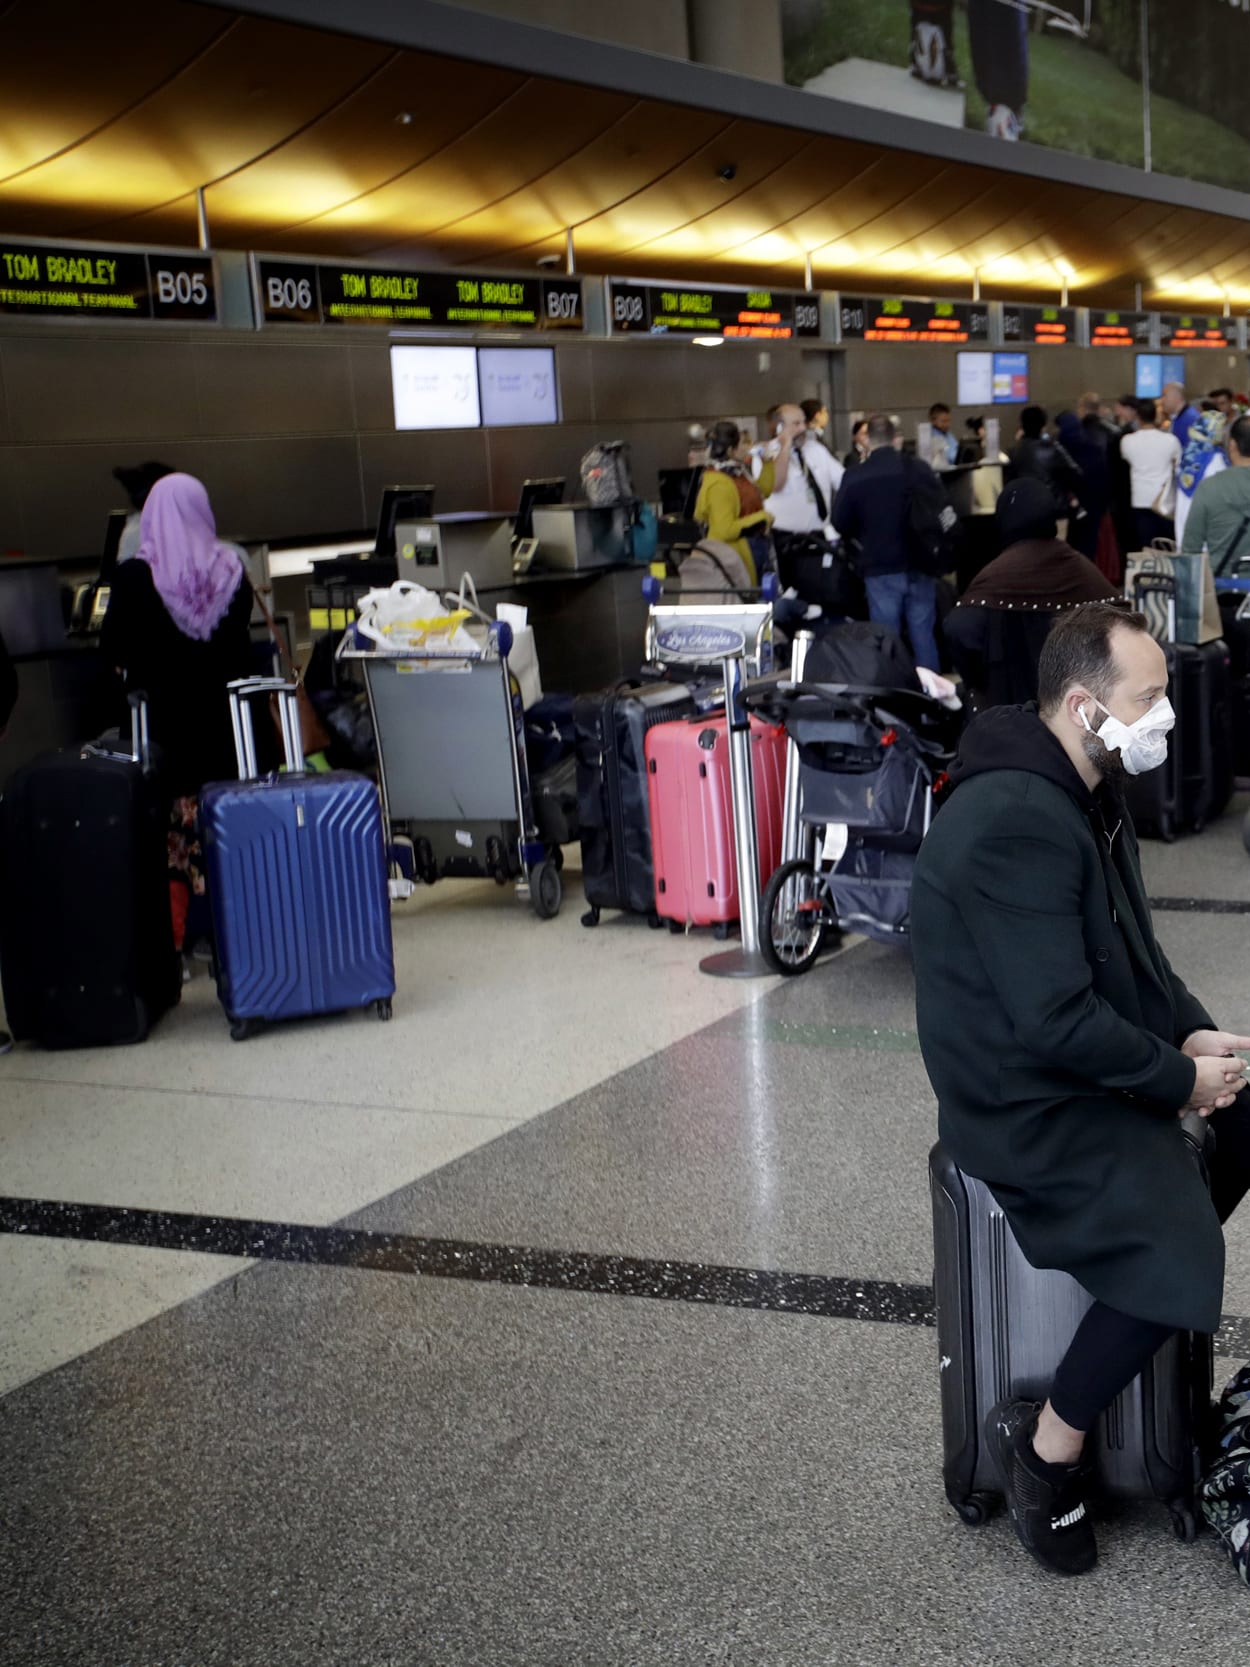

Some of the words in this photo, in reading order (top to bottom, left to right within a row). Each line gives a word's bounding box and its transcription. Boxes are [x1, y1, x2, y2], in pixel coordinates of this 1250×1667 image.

[3, 253, 40, 281] TOM
[46, 255, 116, 285] BRADLEY
[157, 270, 207, 304] B05
[267, 277, 312, 310] B06
[340, 274, 366, 298] TOM
[370, 275, 419, 300] BRADLEY
[456, 280, 479, 303] TOM
[481, 281, 524, 305] BRADLEY
[547, 291, 579, 319] B07
[614, 295, 643, 321] B08
[1050, 1502, 1086, 1530] PUMA
